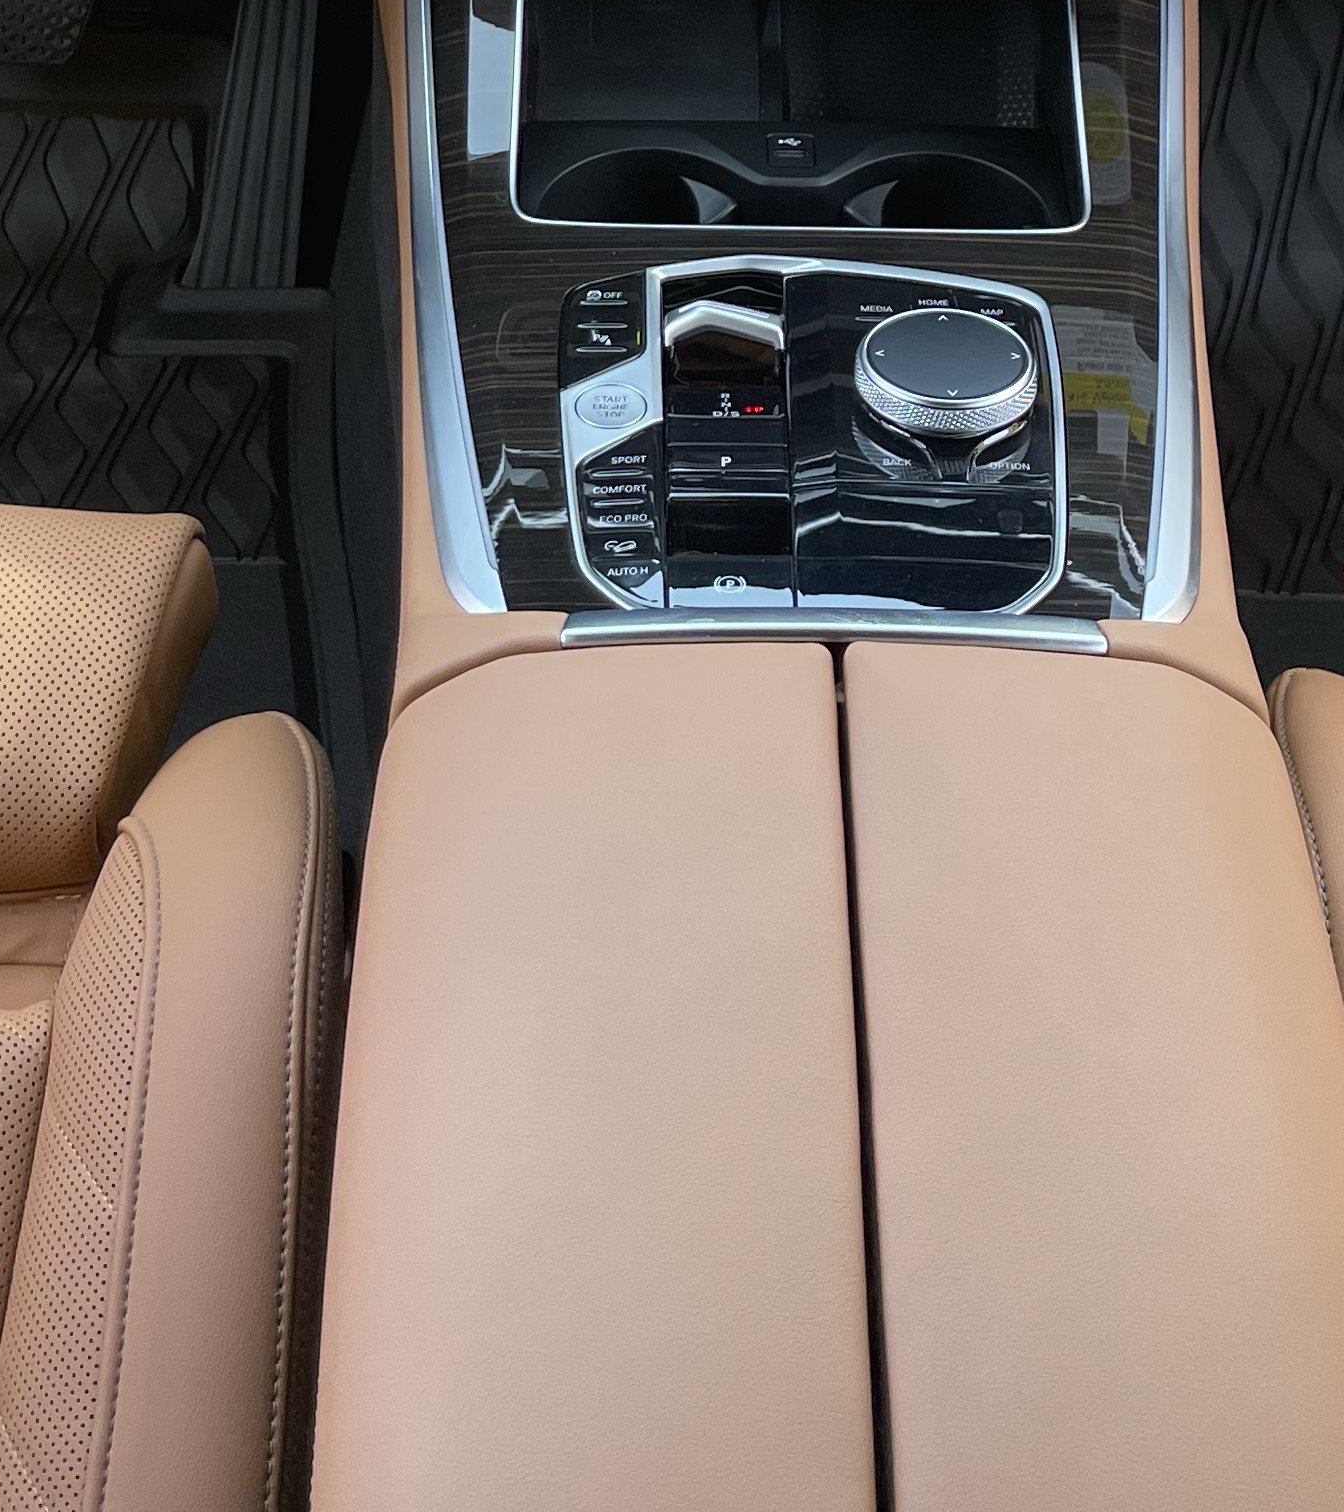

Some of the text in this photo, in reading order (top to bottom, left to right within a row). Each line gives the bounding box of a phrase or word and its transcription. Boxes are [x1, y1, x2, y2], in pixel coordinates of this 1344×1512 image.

[603, 291, 623, 299] OFF
[918, 298, 950, 307] HOME
[860, 304, 894, 314] MEDIA
[980, 308, 1004, 317] MAP
[594, 395, 628, 403] START
[611, 454, 648, 465] SPORT
[720, 456, 732, 467] P
[882, 458, 912, 467] BACK
[989, 462, 1031, 472] OPTION
[592, 484, 647, 494] COMFORT
[599, 513, 648, 523] ECO PRO
[607, 566, 649, 577] AUTO H
